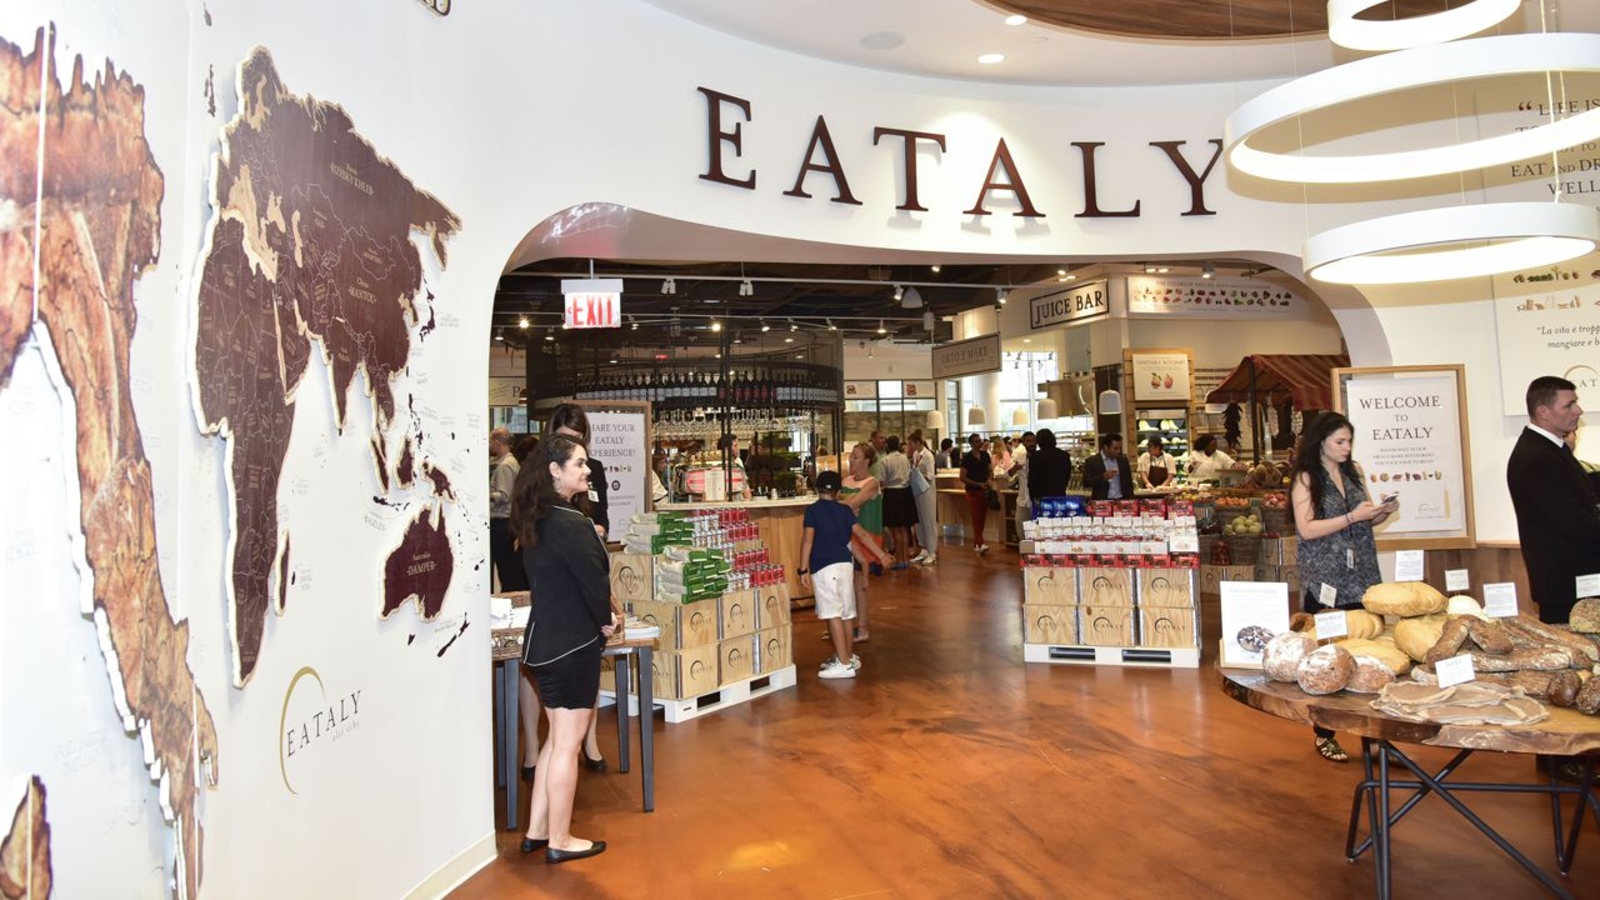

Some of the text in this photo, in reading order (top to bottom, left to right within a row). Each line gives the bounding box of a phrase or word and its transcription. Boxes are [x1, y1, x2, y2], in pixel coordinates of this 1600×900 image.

[697, 86, 1222, 218] EATALY
[1511, 162, 1547, 177] EAT
[573, 294, 615, 326] EXIT
[1034, 290, 1104, 325] JUICE BAR
[1547, 339, 1585, 350] mangiare
[1360, 396, 1441, 409] WELCOME
[1394, 414, 1408, 422] TO
[590, 423, 636, 432] HARE YOUR
[1372, 427, 1433, 440] EATALY
[595, 436, 625, 445] EATALY
[589, 448, 636, 457] XPERIENCE!
[287, 690, 361, 758] EATALY
